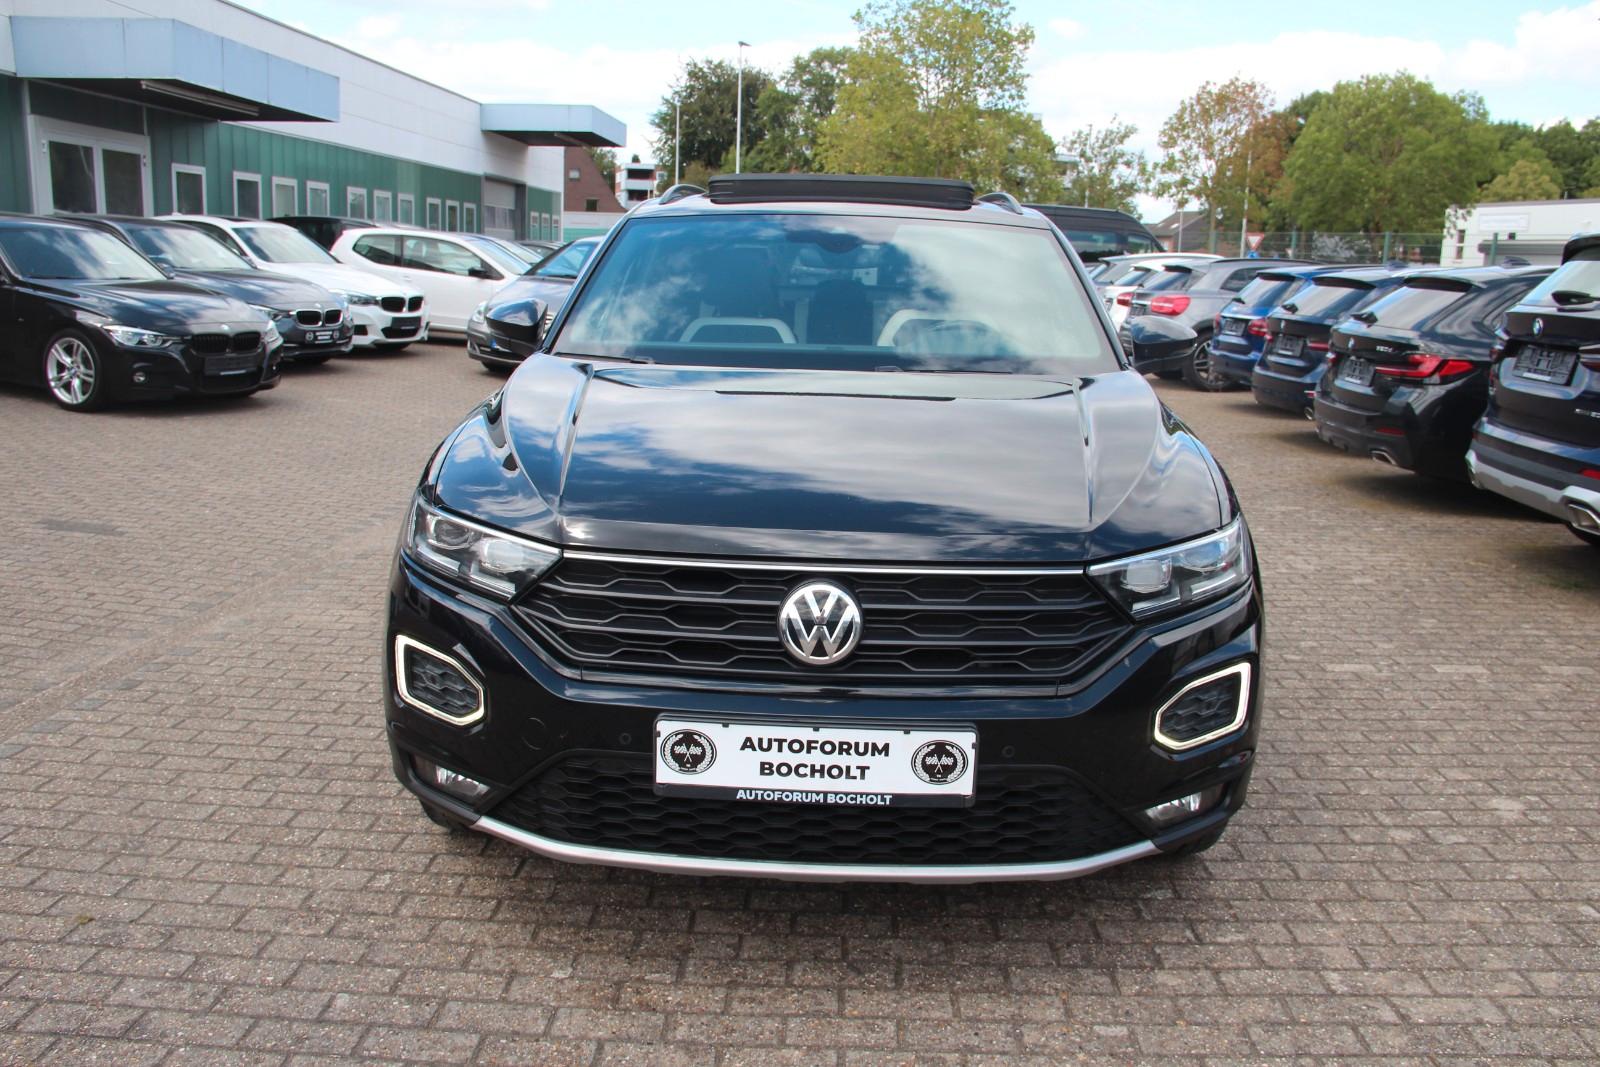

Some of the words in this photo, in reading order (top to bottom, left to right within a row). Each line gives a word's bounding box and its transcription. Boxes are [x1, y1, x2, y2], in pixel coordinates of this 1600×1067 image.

[781, 585, 860, 663] VW
[739, 736, 890, 757] AUTOFORUM
[759, 761, 870, 780] BOCHOLT
[736, 789, 824, 803] AUTOFORUM
[826, 793, 893, 806] BOCHOLT
